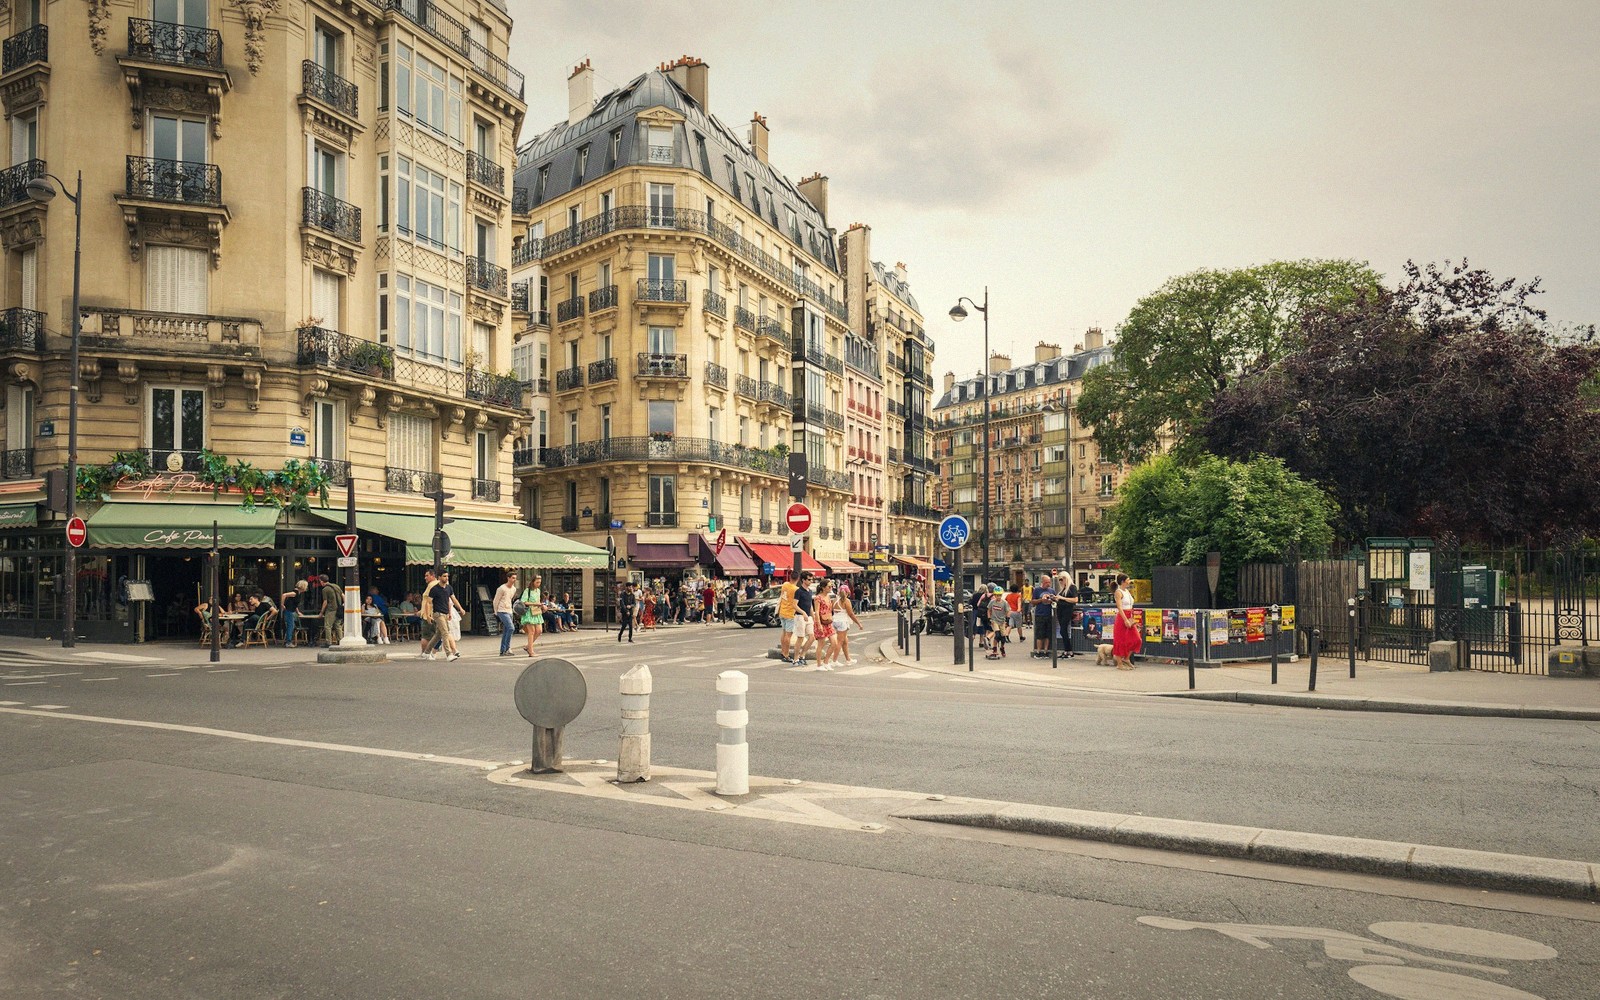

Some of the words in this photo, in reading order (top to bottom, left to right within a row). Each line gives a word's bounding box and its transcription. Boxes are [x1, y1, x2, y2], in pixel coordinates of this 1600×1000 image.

[116, 472, 165, 499] Café
[164, 473, 223, 493] Pari
[143, 529, 180, 543] Café
